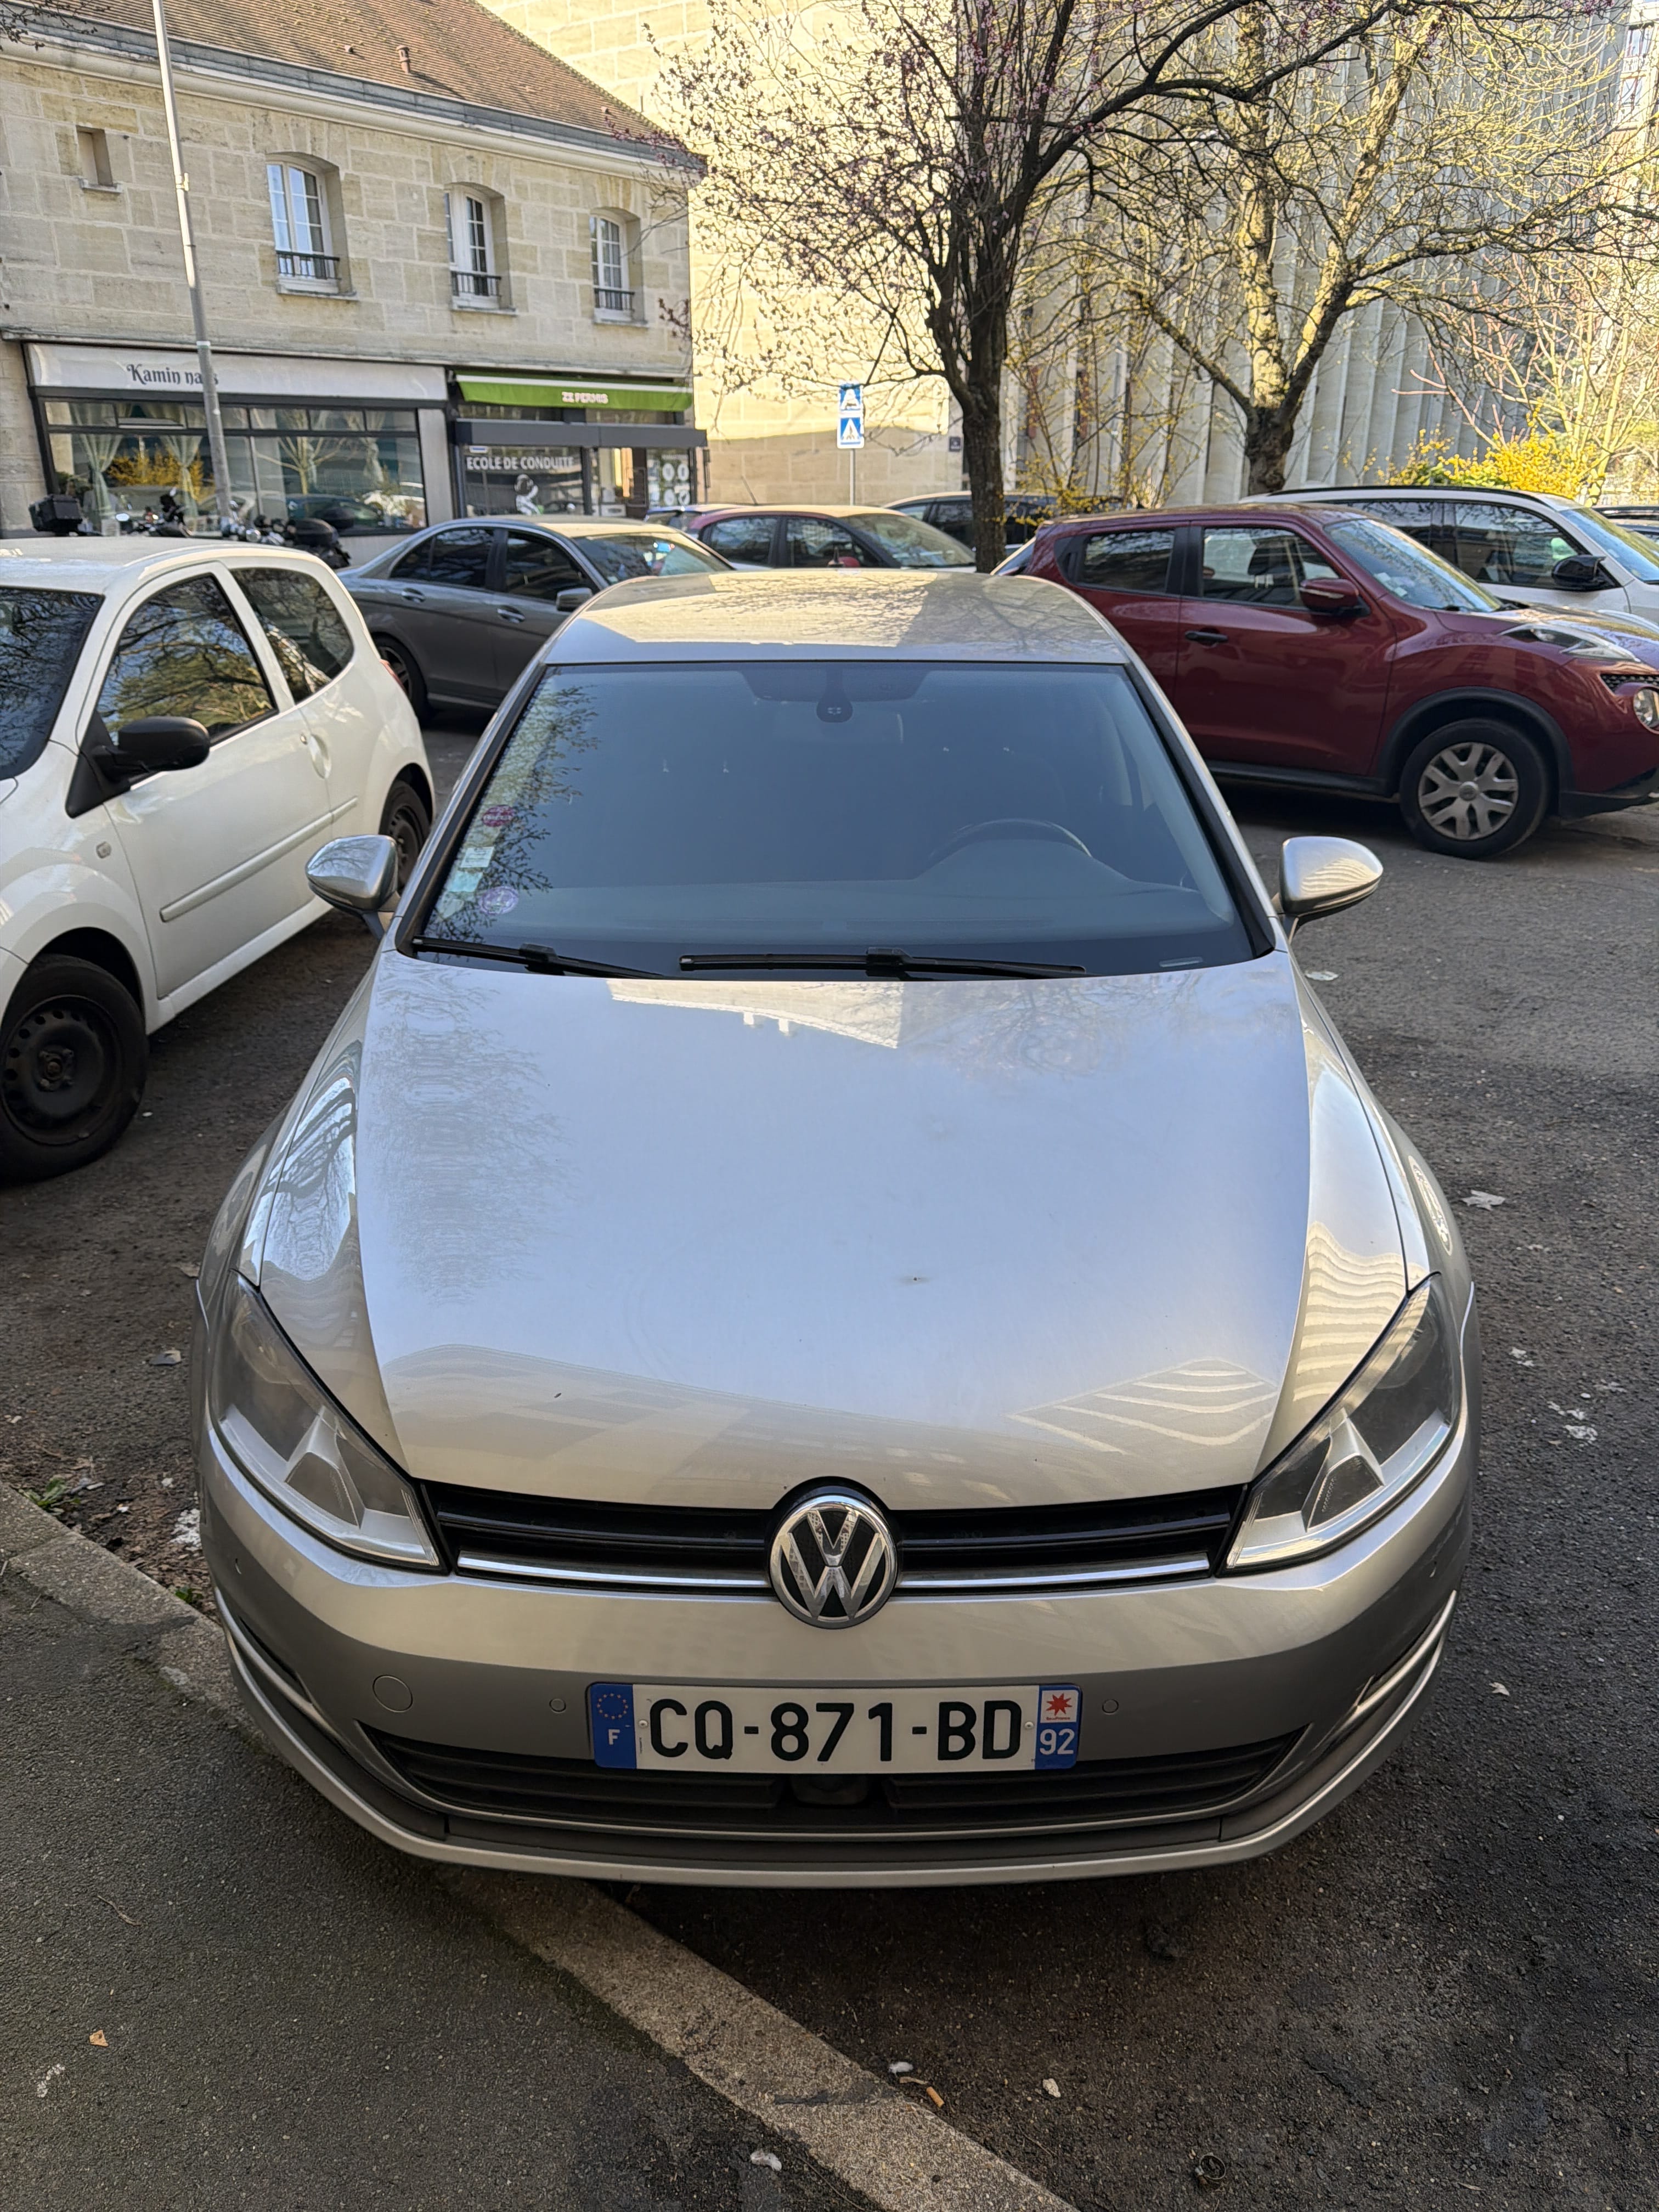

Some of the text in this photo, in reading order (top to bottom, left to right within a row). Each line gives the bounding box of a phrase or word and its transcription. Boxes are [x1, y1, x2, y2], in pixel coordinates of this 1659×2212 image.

[127, 364, 218, 386] Kamin nas
[466, 456, 574, 470] ECOLE DE CONDUITE
[608, 1729, 620, 1745] F
[650, 1699, 1022, 1762] CQ-871-BD
[1040, 1728, 1075, 1755] 92
